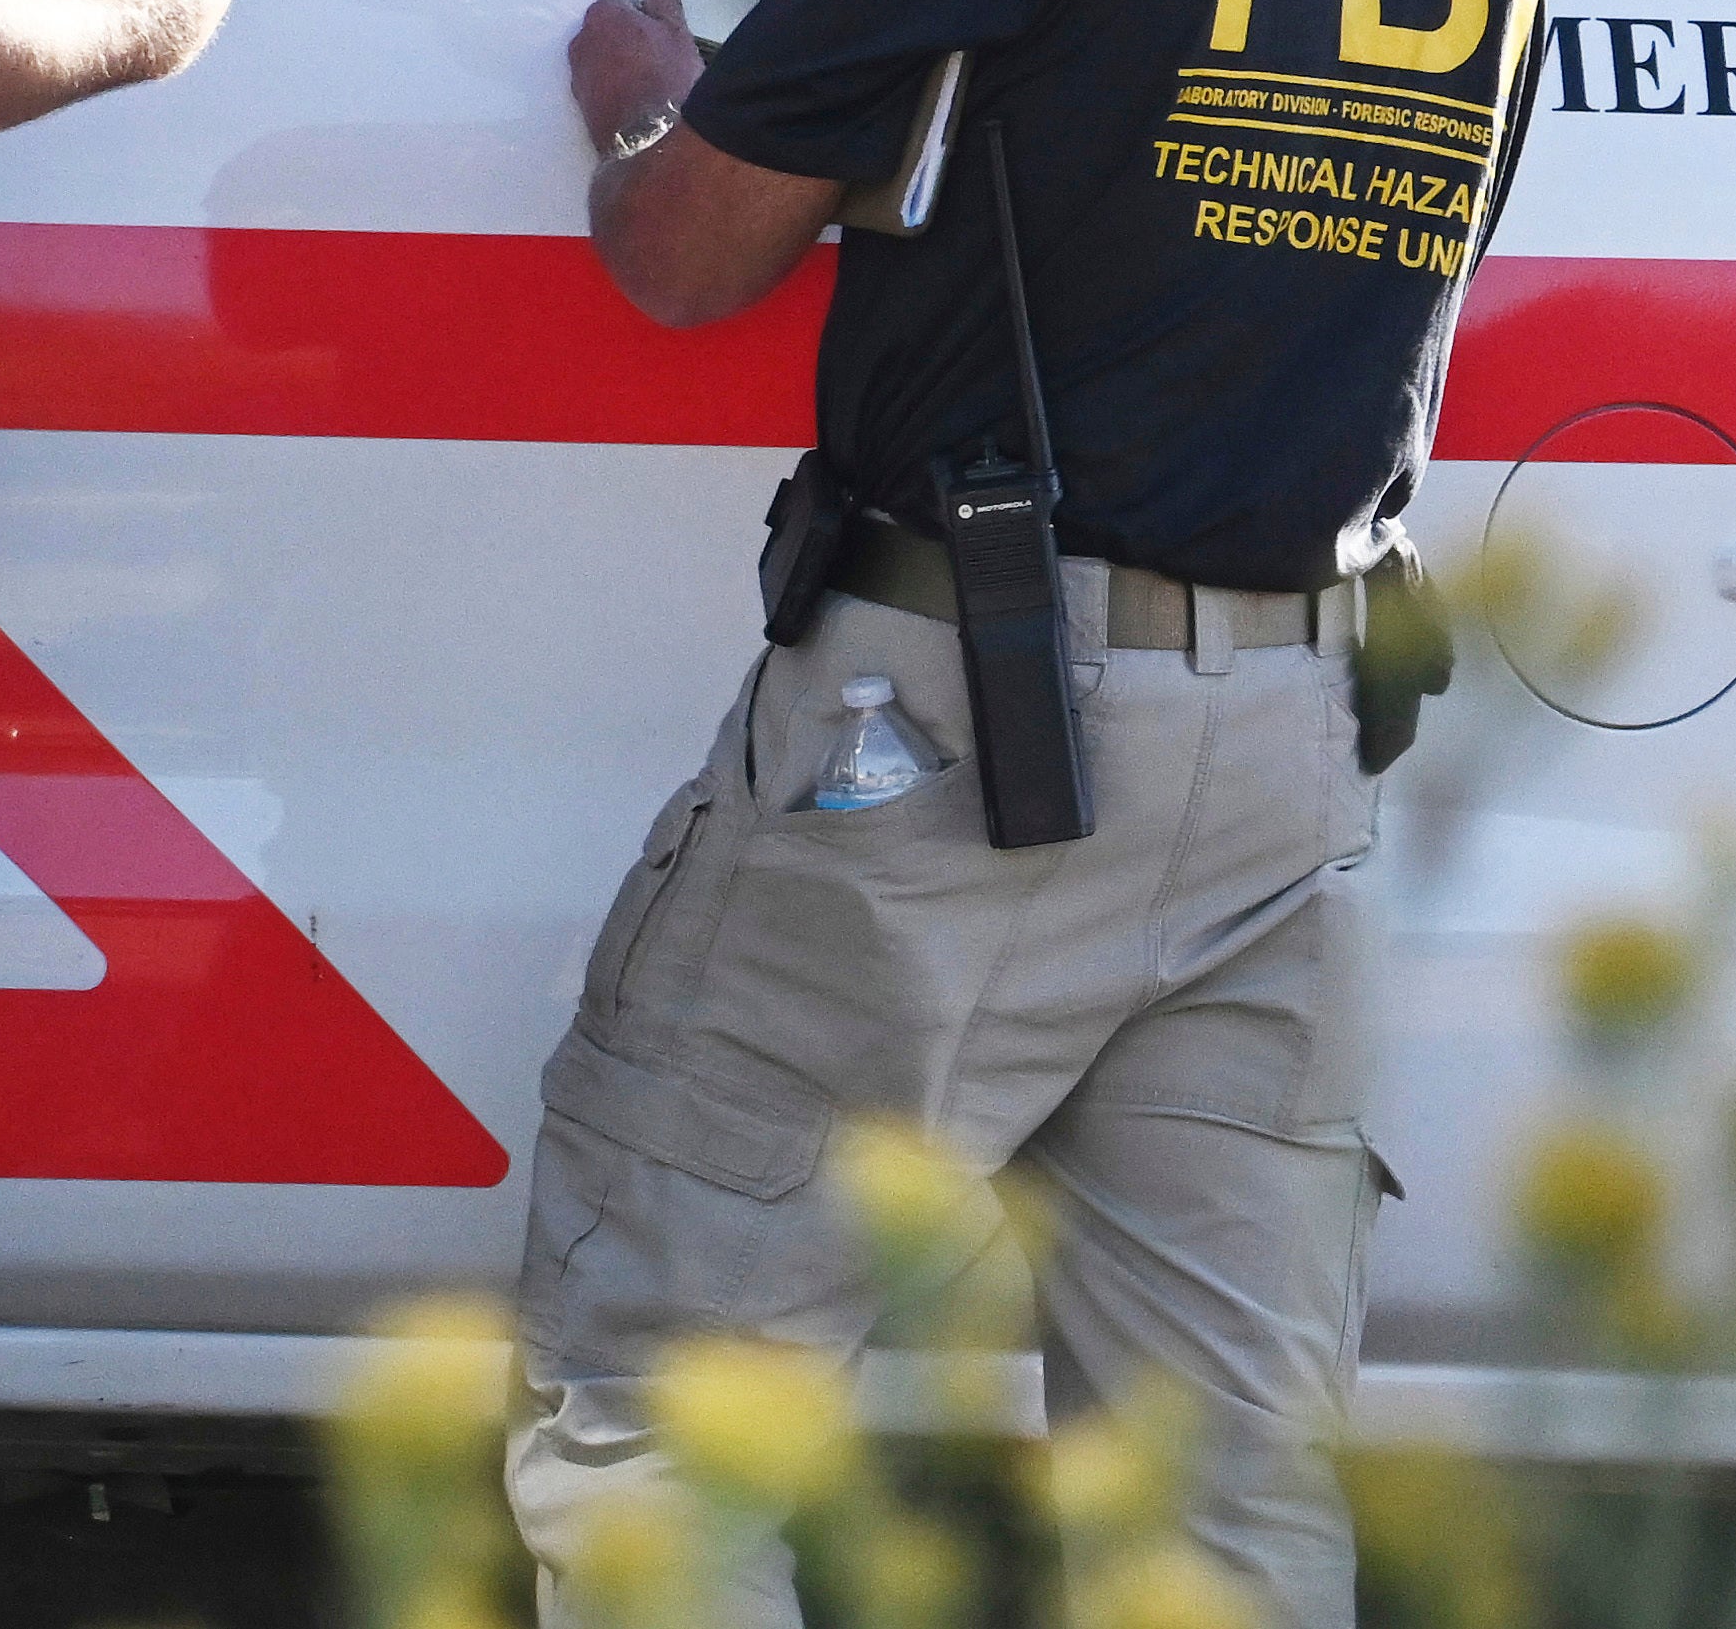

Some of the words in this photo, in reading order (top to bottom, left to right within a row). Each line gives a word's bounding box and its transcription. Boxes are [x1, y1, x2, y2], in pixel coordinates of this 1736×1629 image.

[1272, 92, 1331, 116] DIVISION
[1154, 141, 1357, 201] TECHNICAL
[1194, 199, 1389, 260] RESPONSE
[1398, 229, 1471, 278] UNI
